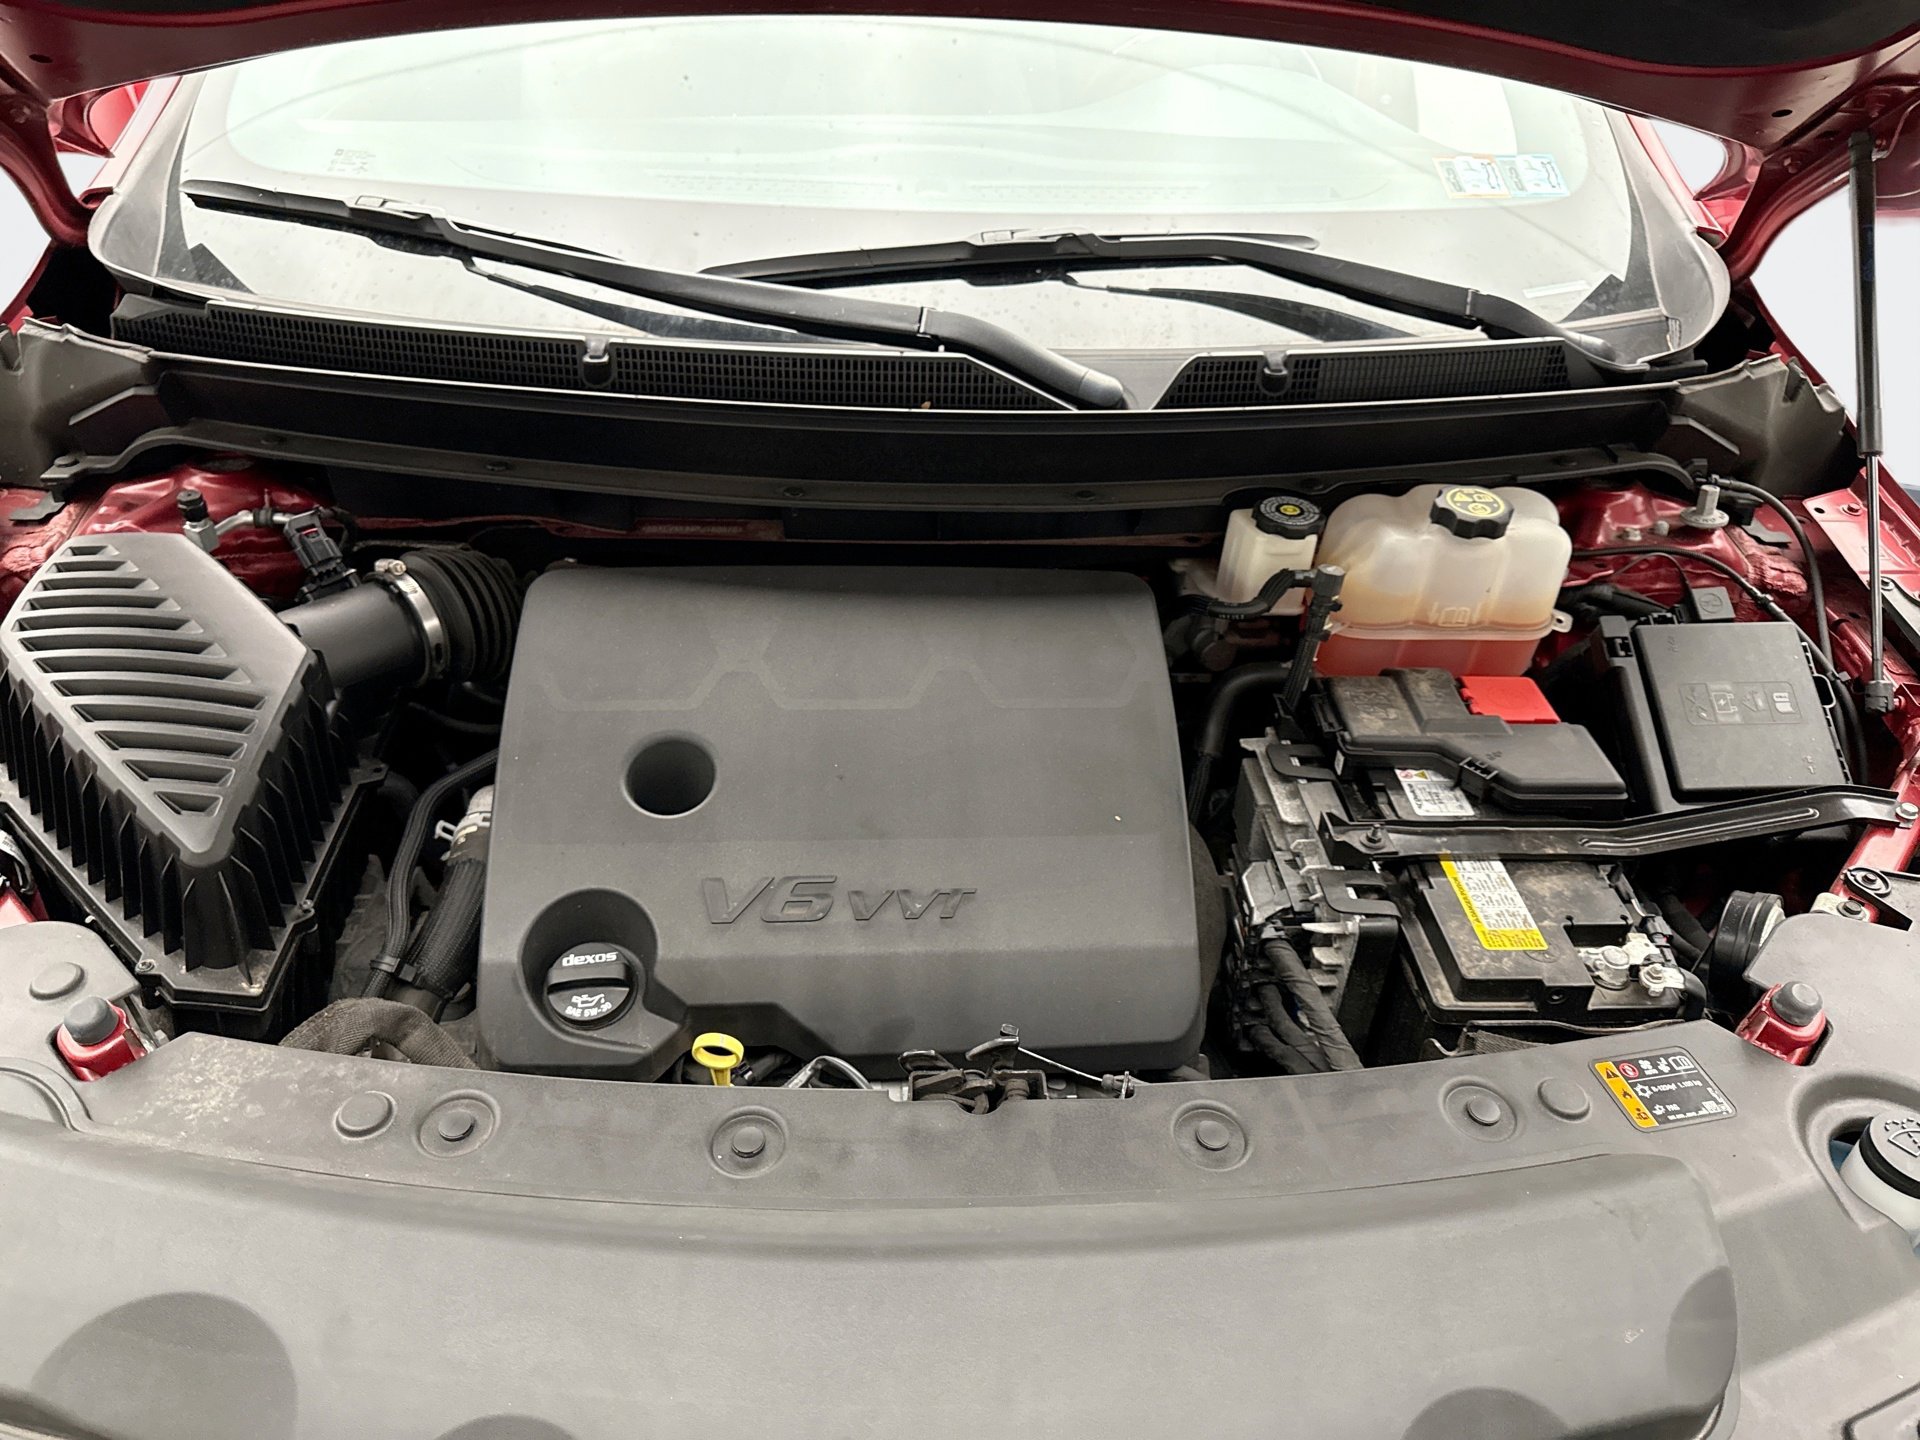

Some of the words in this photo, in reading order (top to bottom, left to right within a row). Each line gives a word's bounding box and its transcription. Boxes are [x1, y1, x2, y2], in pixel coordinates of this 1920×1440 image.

[701, 875, 838, 925] V6
[846, 887, 978, 922] VVT
[562, 951, 618, 967] dexos
[565, 1005, 583, 1017] SAE
[583, 1001, 612, 1018] 5W-30
